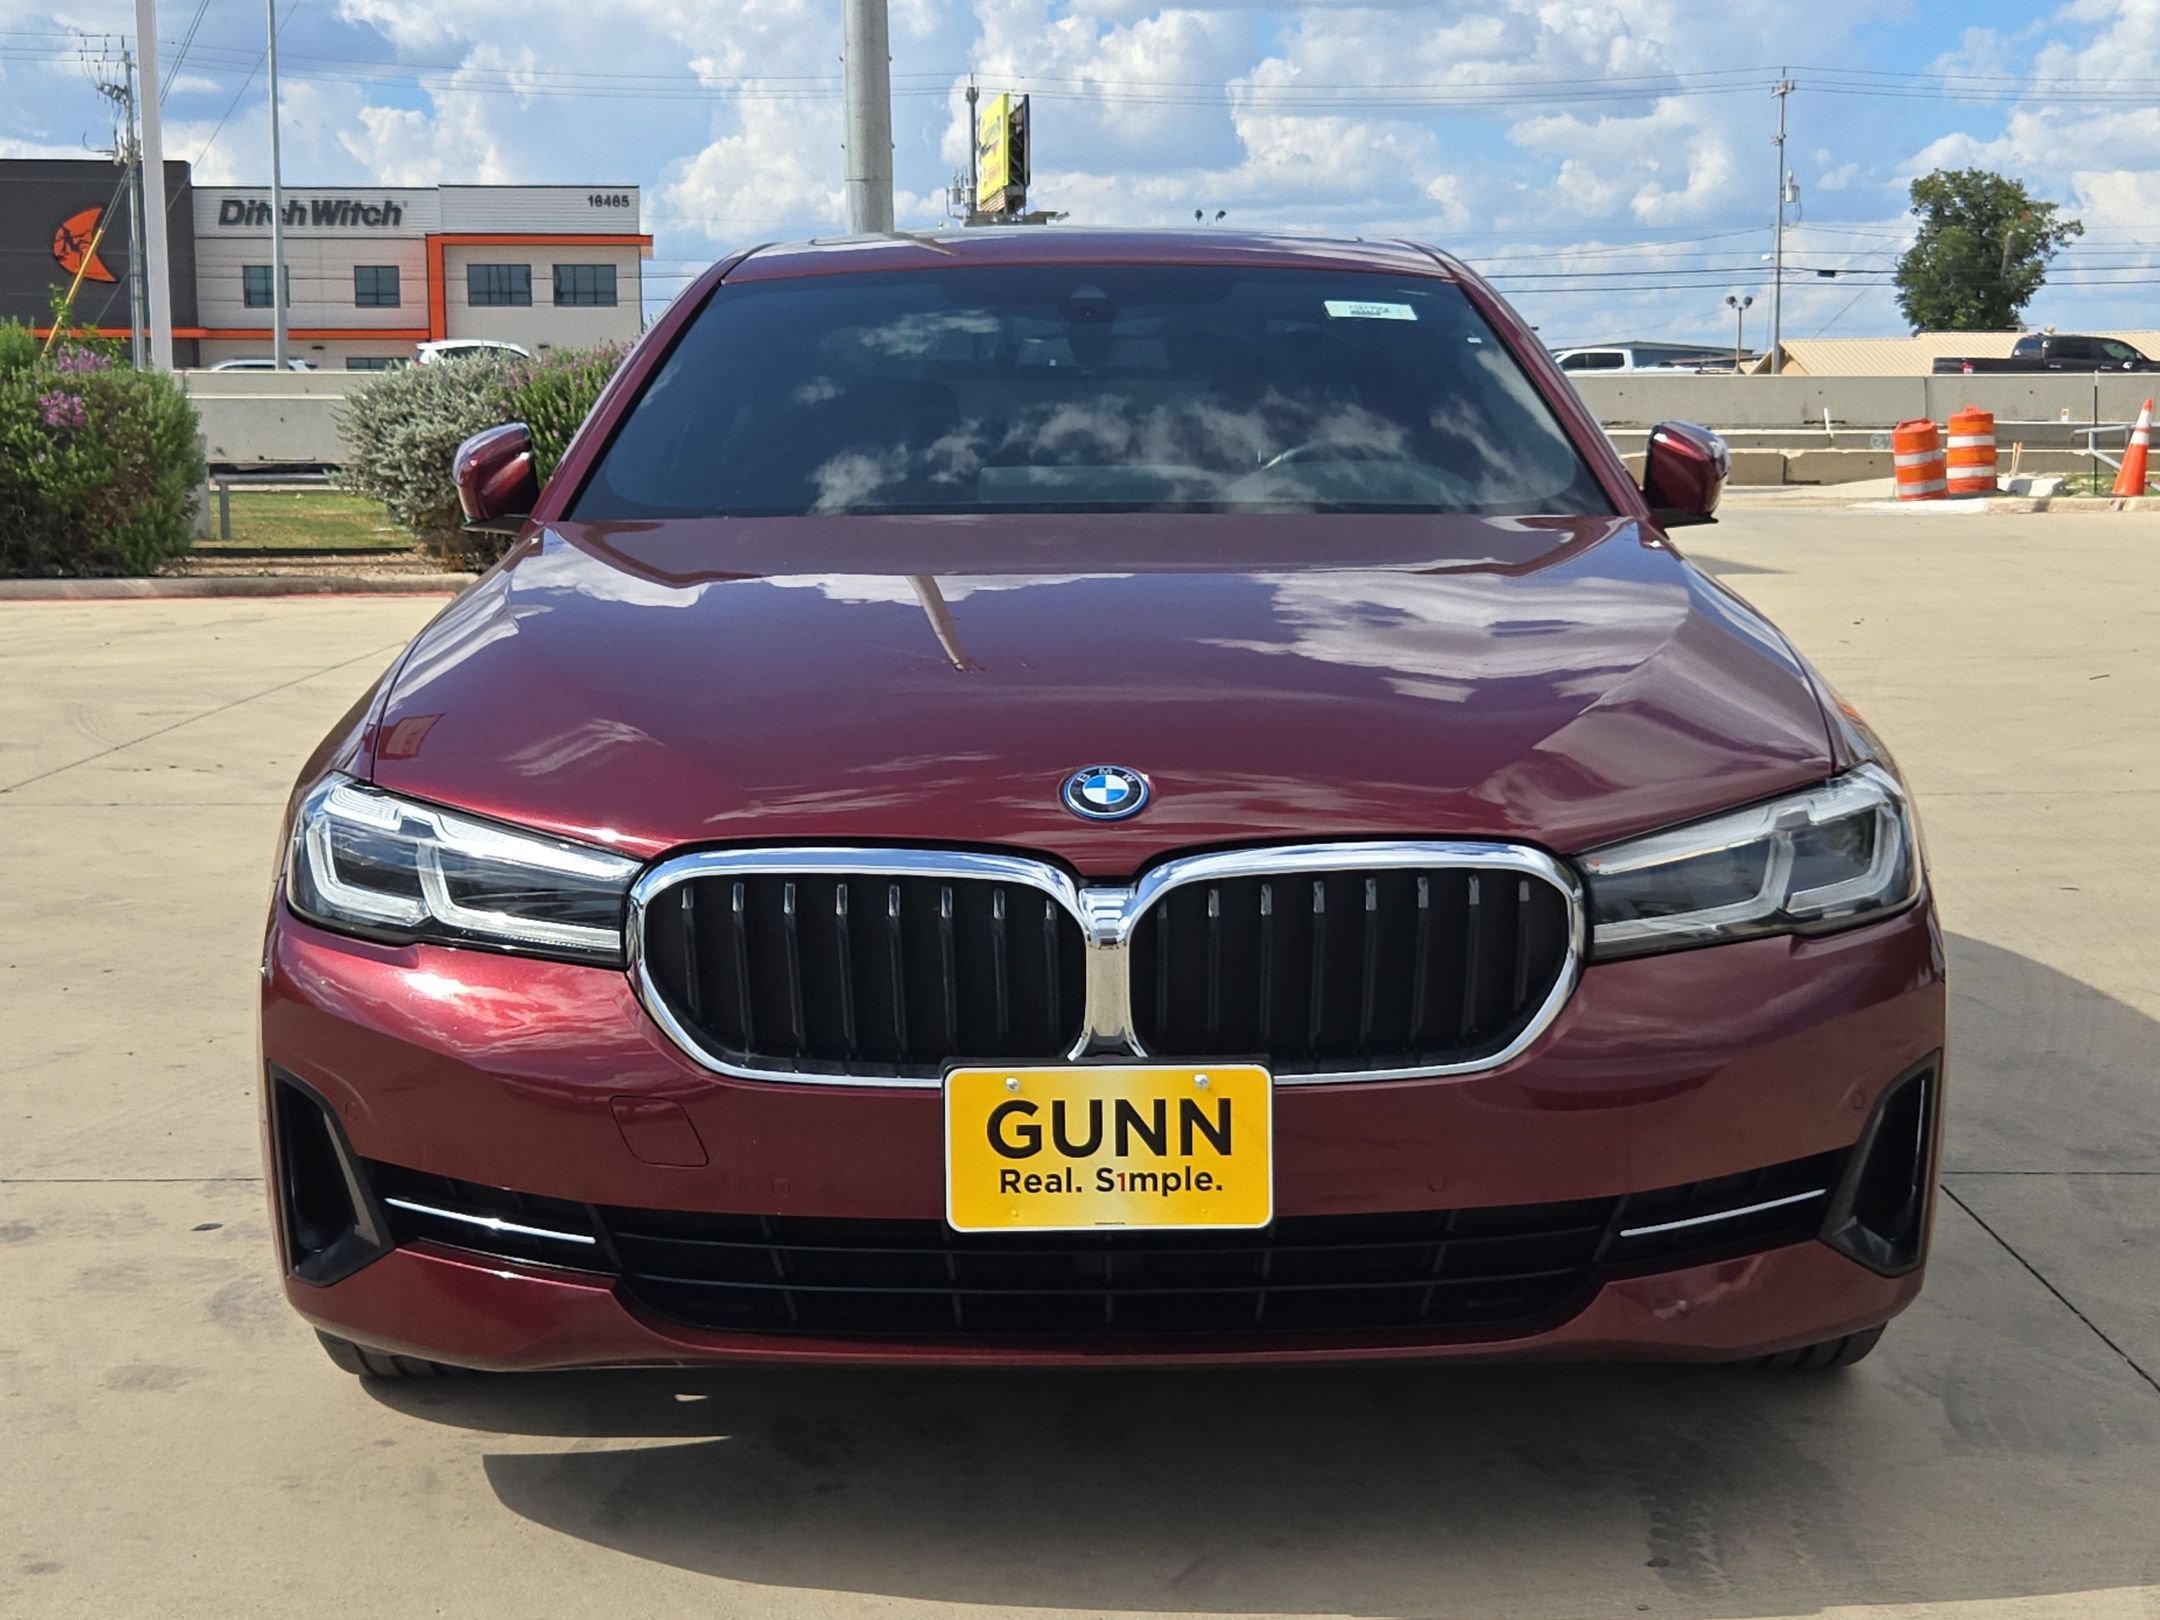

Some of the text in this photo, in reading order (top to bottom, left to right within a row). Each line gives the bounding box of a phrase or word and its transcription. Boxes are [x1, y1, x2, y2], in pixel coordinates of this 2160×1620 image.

[311, 199, 402, 226] Witch
[588, 194, 630, 208] 16465
[1076, 767, 1136, 783] BMW
[986, 1098, 1232, 1159] GUNN
[999, 1165, 1223, 1197] Real. S1mple.
